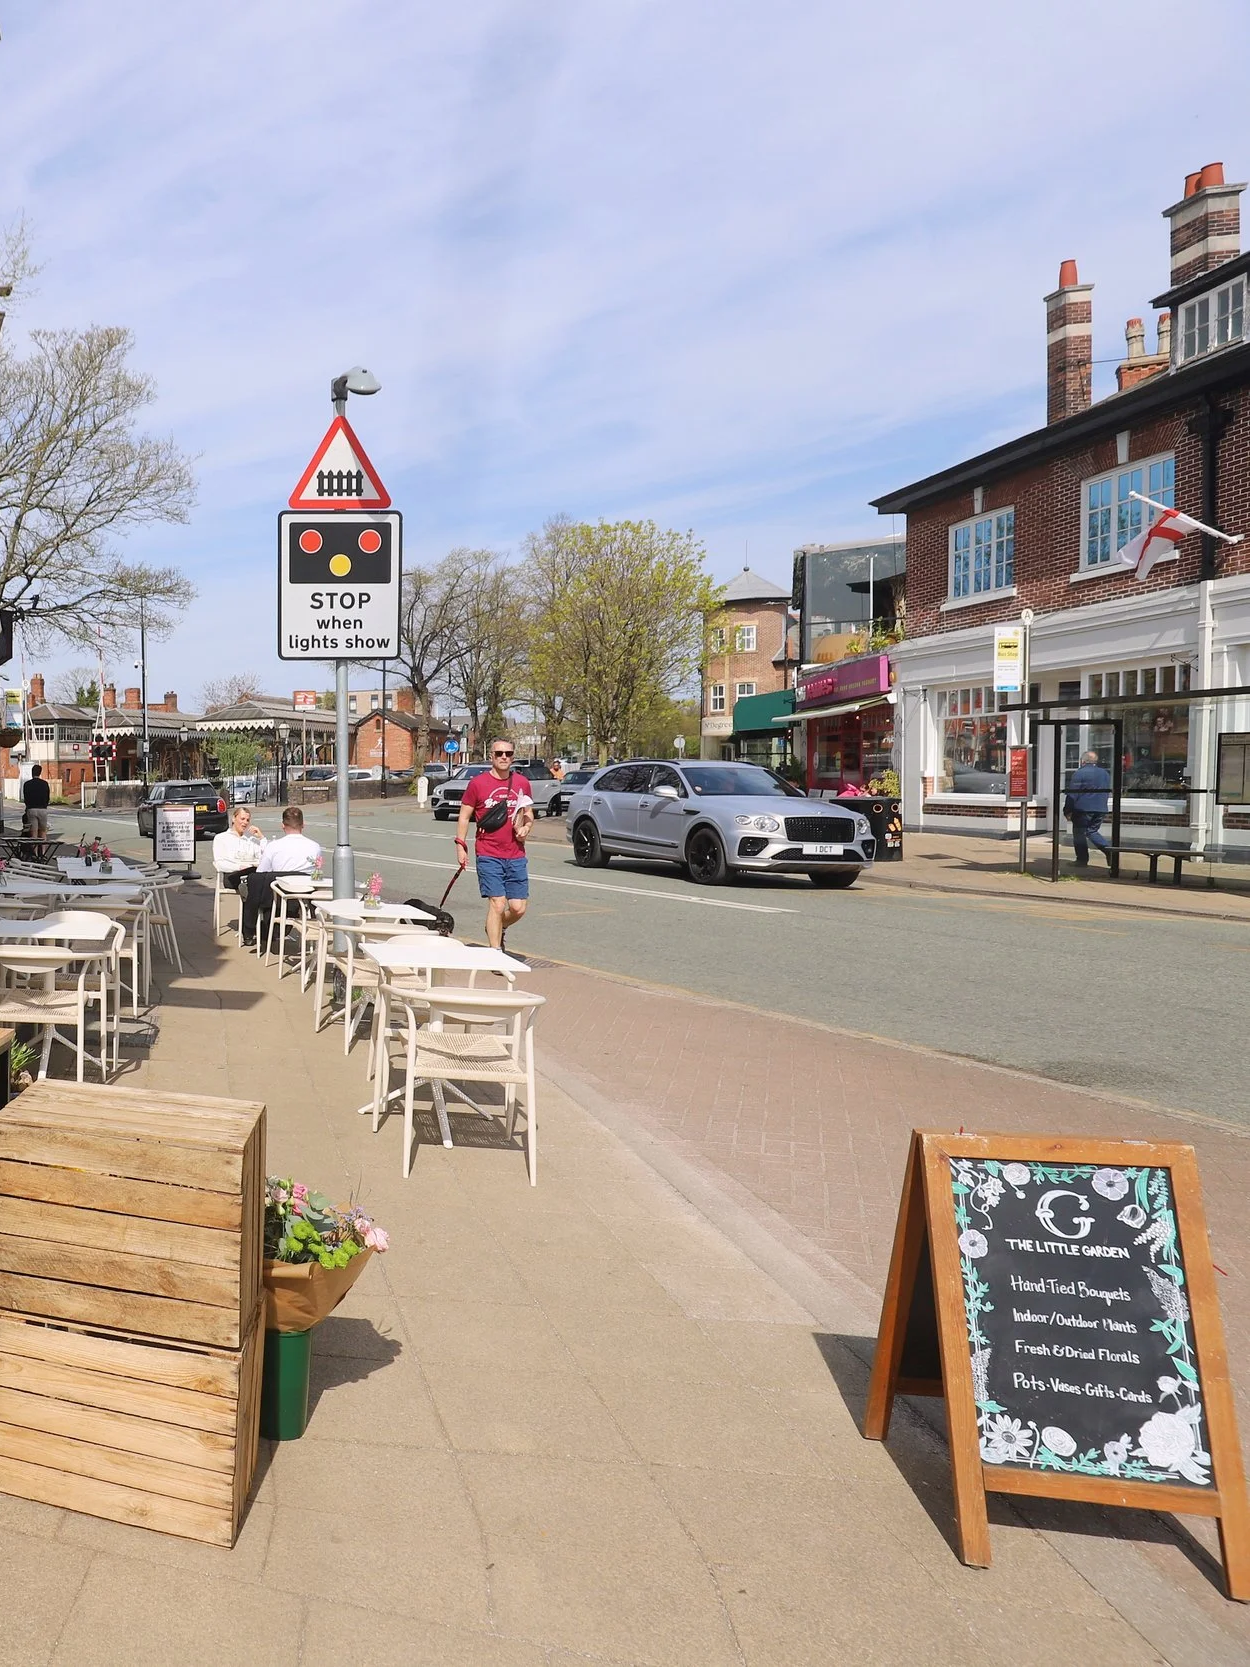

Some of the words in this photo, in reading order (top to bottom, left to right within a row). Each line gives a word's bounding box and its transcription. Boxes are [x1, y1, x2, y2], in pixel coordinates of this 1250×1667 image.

[309, 592, 371, 610] STOP
[316, 616, 363, 630] when
[288, 634, 339, 652] lights
[344, 634, 390, 649] show
[819, 845, 833, 853] DCT
[1035, 1190, 1095, 1239] G
[1005, 1239, 1033, 1252] THE
[1035, 1240, 1080, 1256] LITTLE
[1081, 1245, 1130, 1259] GARDEN
[1010, 1274, 1076, 1296] Hand-Tied
[1077, 1281, 1131, 1306] Bouquets
[1013, 1308, 1100, 1330] Indoor/Outdoor
[1014, 1339, 1051, 1357] Fresh
[1098, 1348, 1140, 1365] Florals
